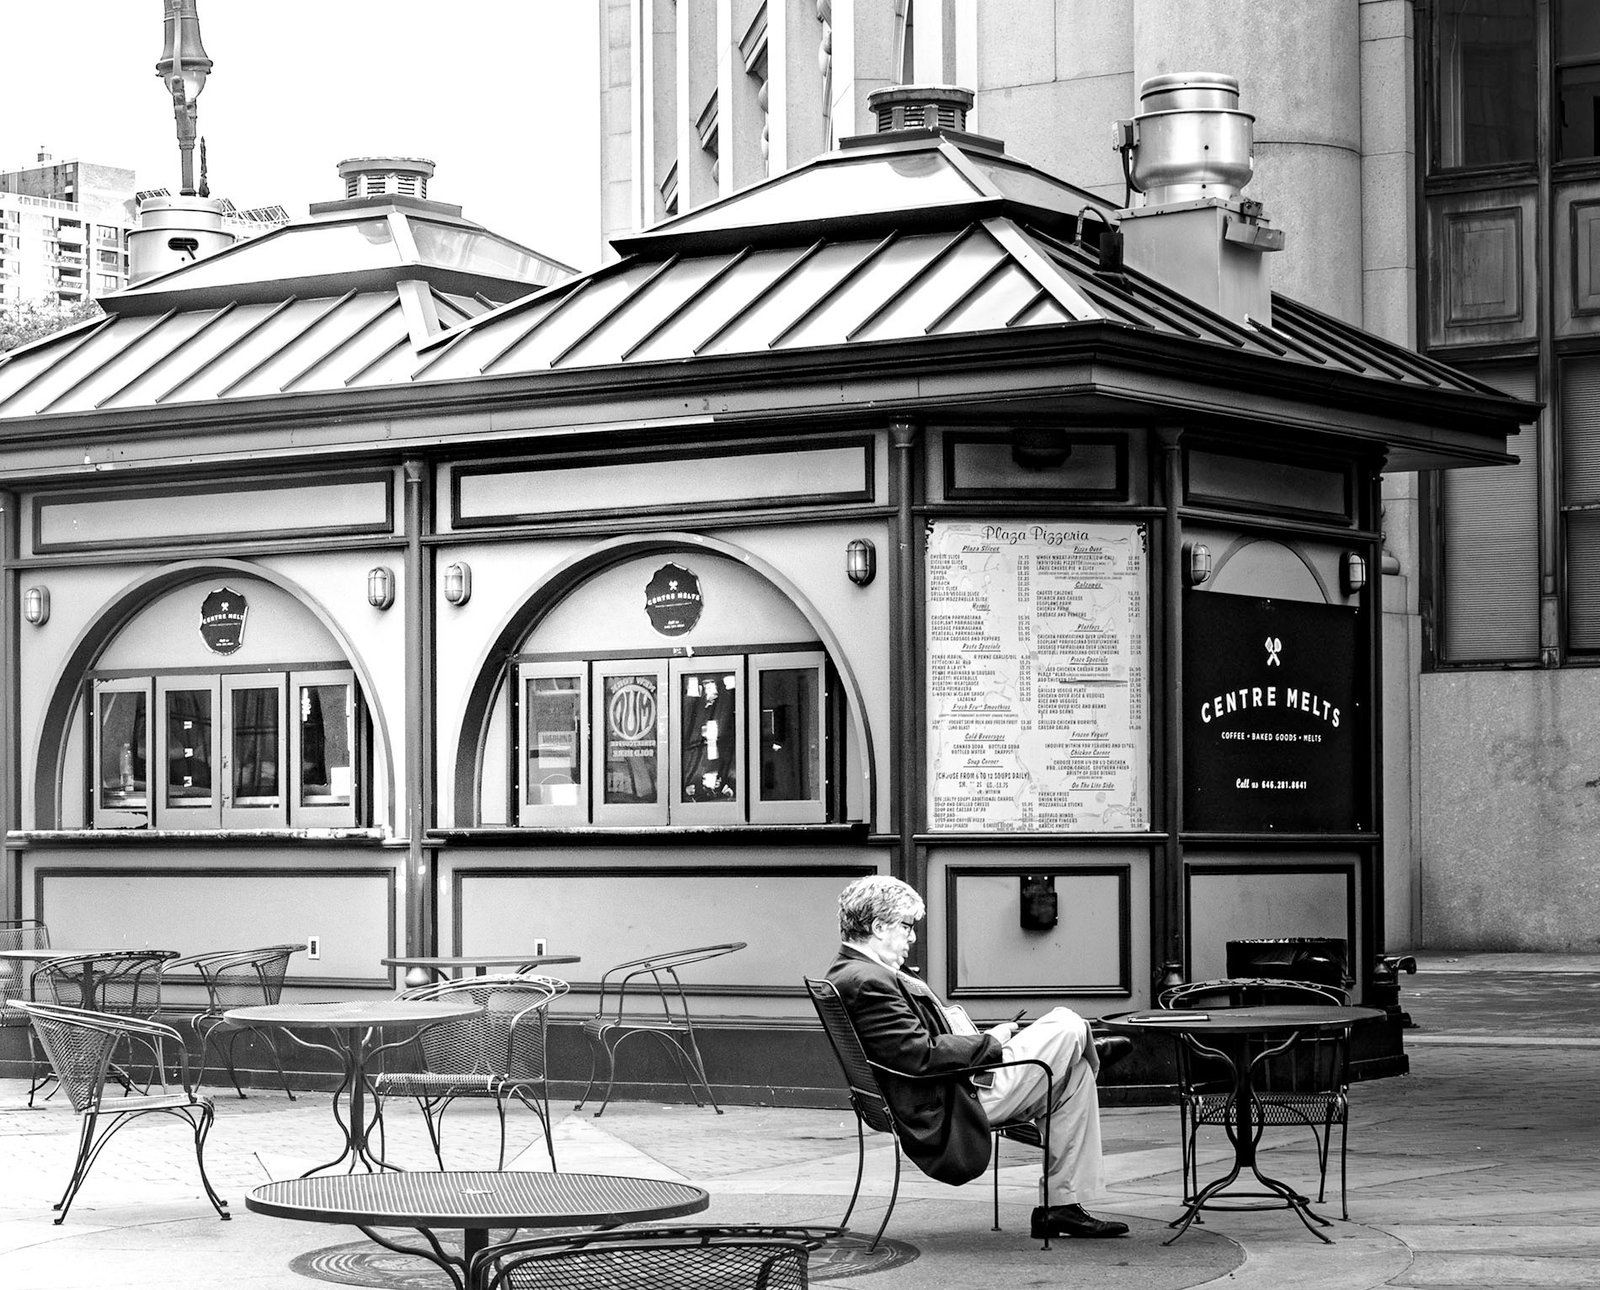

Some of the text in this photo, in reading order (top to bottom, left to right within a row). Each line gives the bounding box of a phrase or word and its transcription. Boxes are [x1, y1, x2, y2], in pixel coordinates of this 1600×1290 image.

[982, 526, 1089, 545] Plaza Pizzeria
[648, 592, 699, 605] CENTRE MELTS
[203, 614, 226, 624] CENTRE
[1201, 687, 1340, 727] CENTRE MELTS
[1236, 778, 1249, 788] Call
[1261, 780, 1307, 789] 646.281.8641
